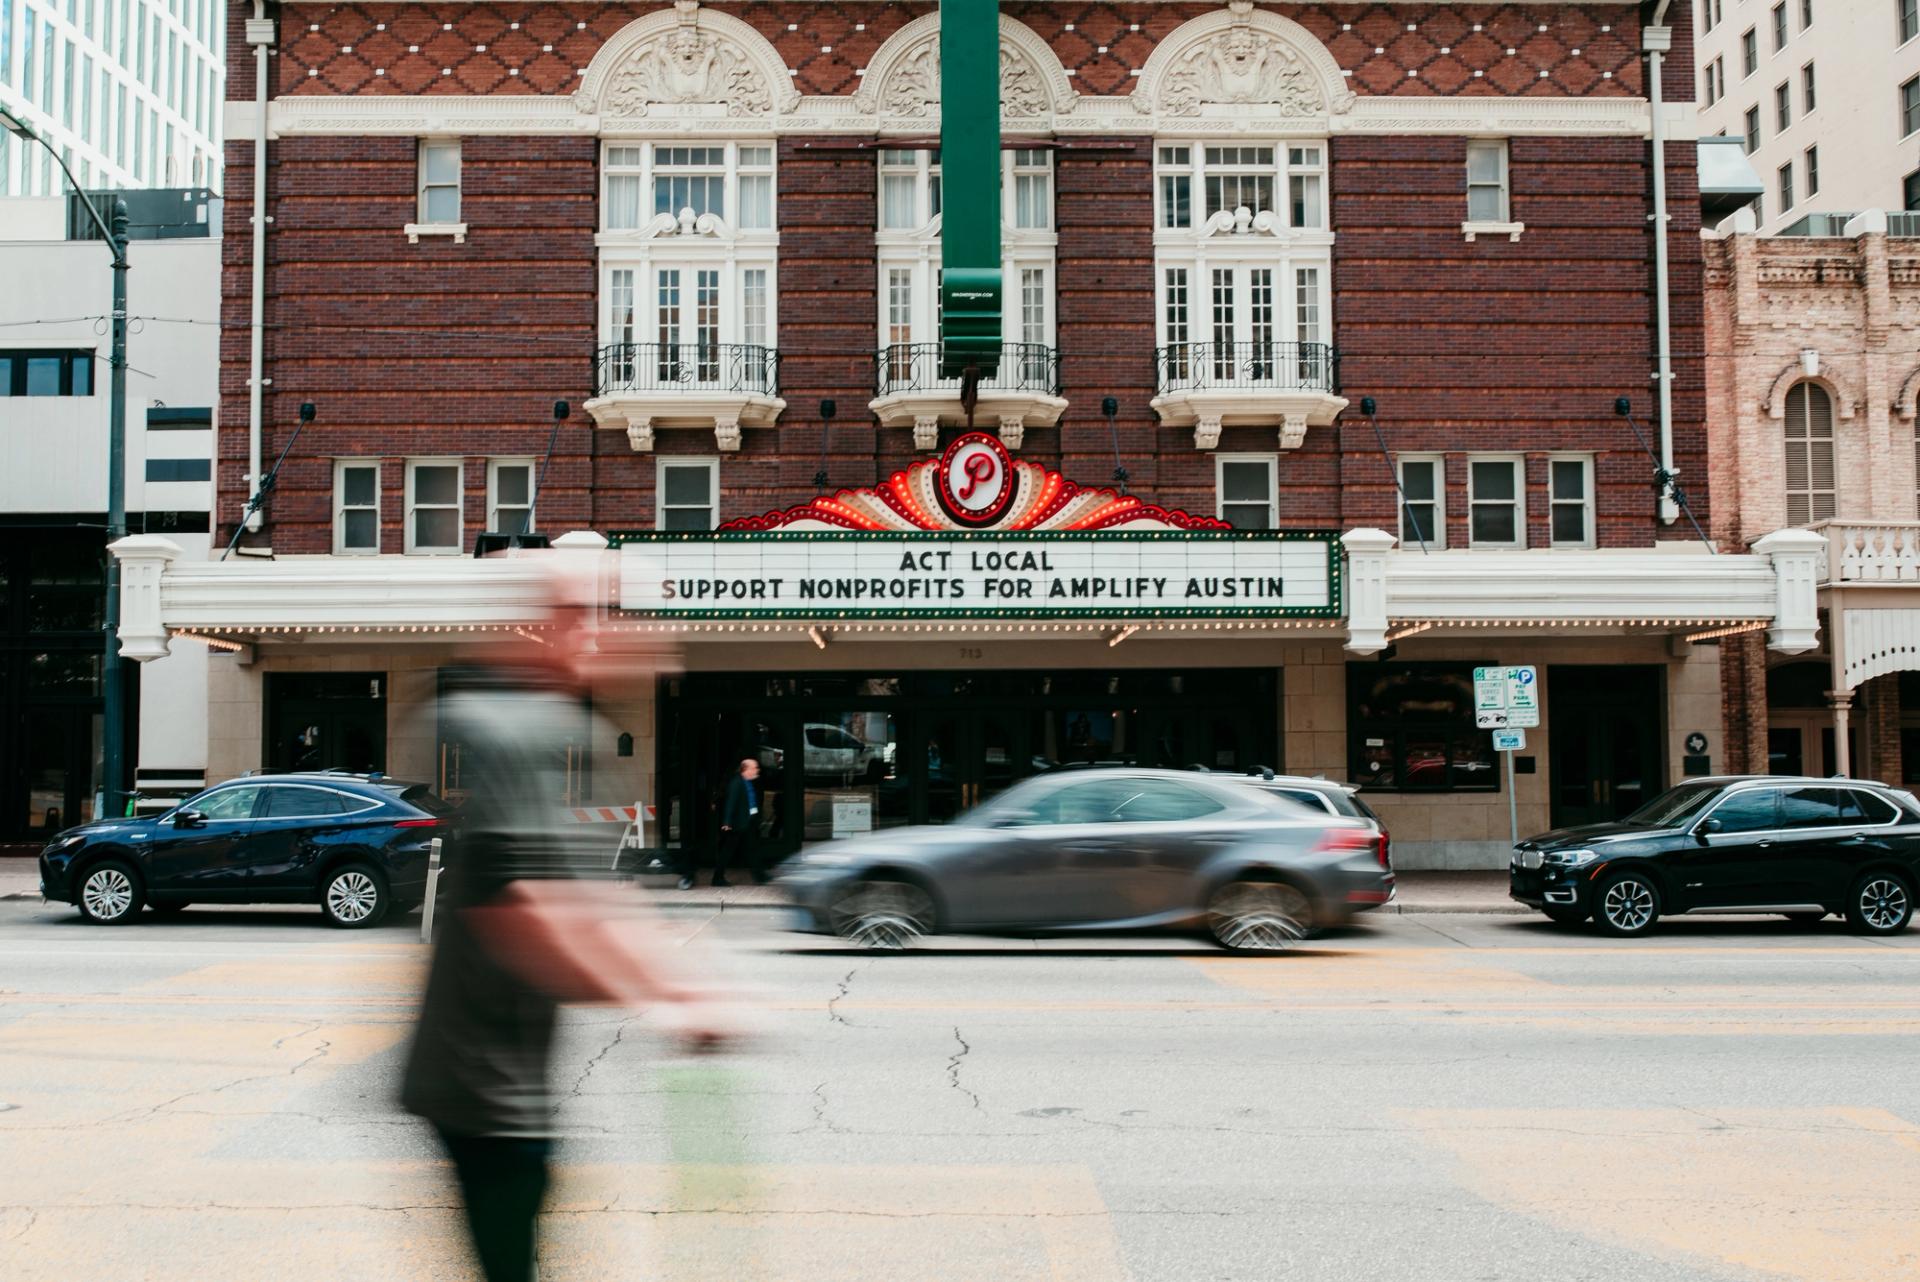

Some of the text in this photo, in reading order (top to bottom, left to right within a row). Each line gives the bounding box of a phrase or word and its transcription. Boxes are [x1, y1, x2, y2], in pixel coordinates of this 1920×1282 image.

[899, 551, 1054, 571] ACT LOCAL
[662, 577, 1284, 599] SUPPORT NONPROFITS FOR AMPLIFY AUSTIN
